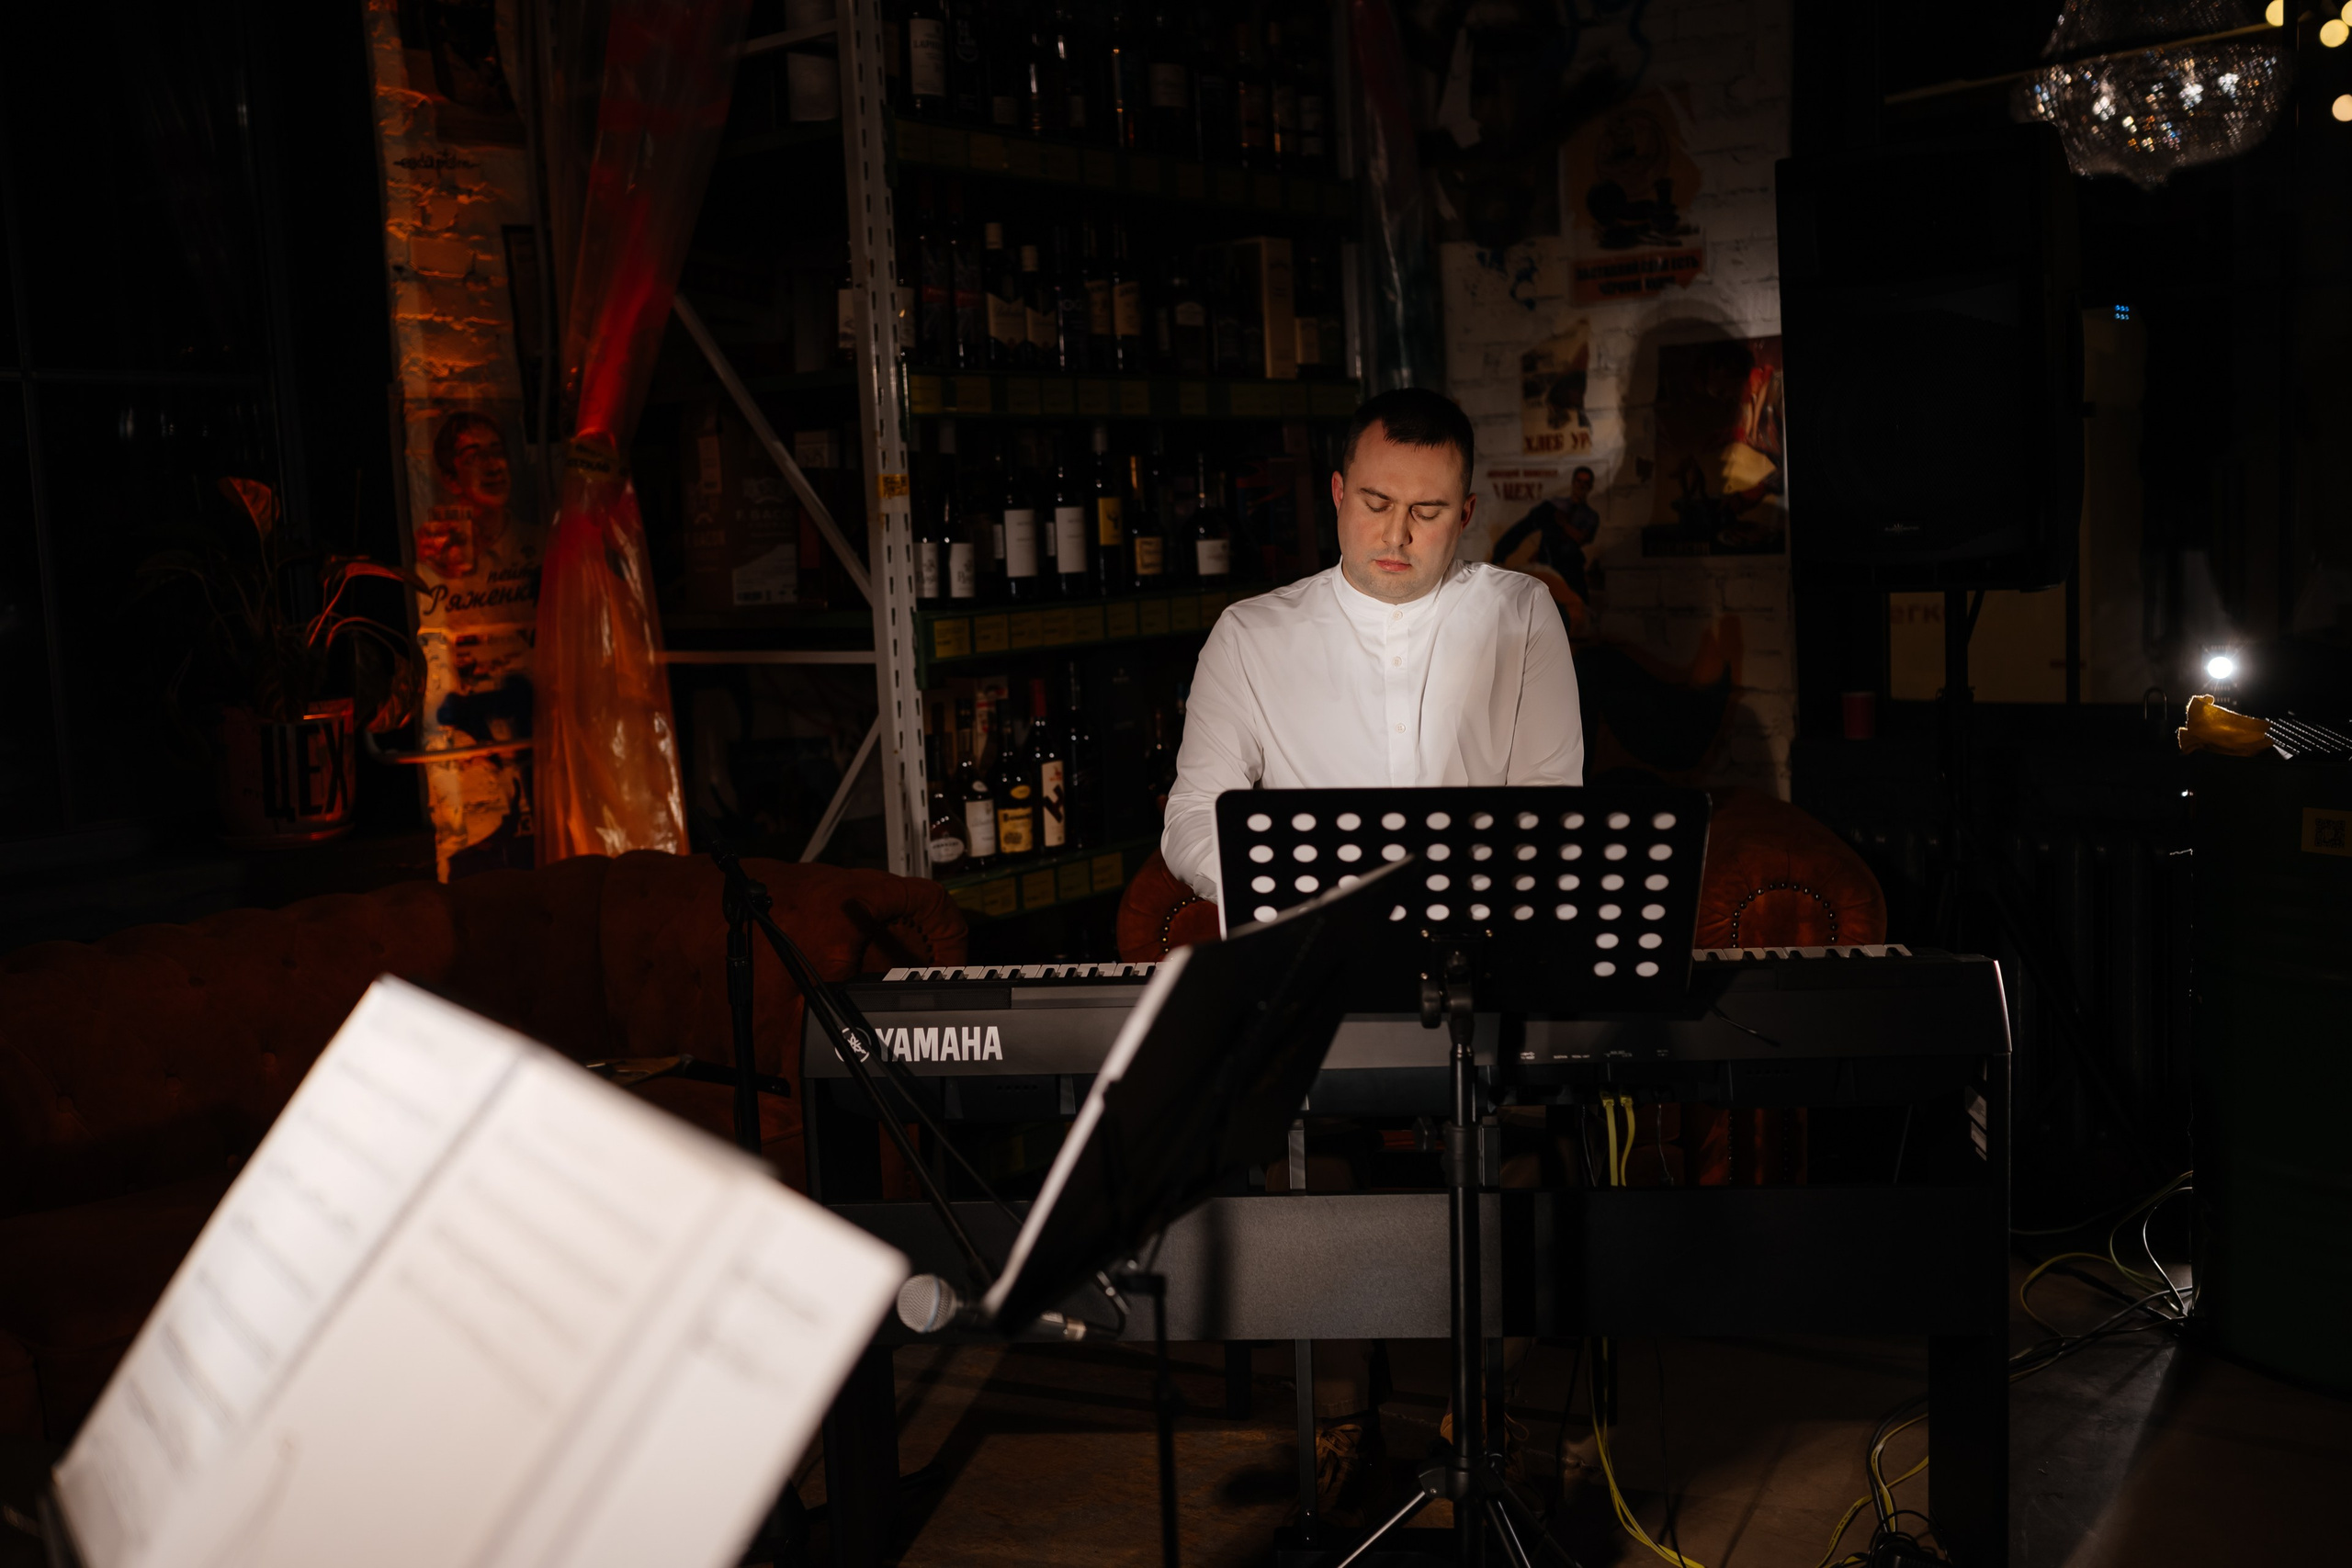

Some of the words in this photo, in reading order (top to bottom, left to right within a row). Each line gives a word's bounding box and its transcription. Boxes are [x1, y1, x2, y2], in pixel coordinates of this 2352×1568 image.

[1525, 434, 1564, 452] ХЛЕБ
[261, 721, 348, 823] ЦЕХ
[875, 1025, 1003, 1063] YAMAHA
